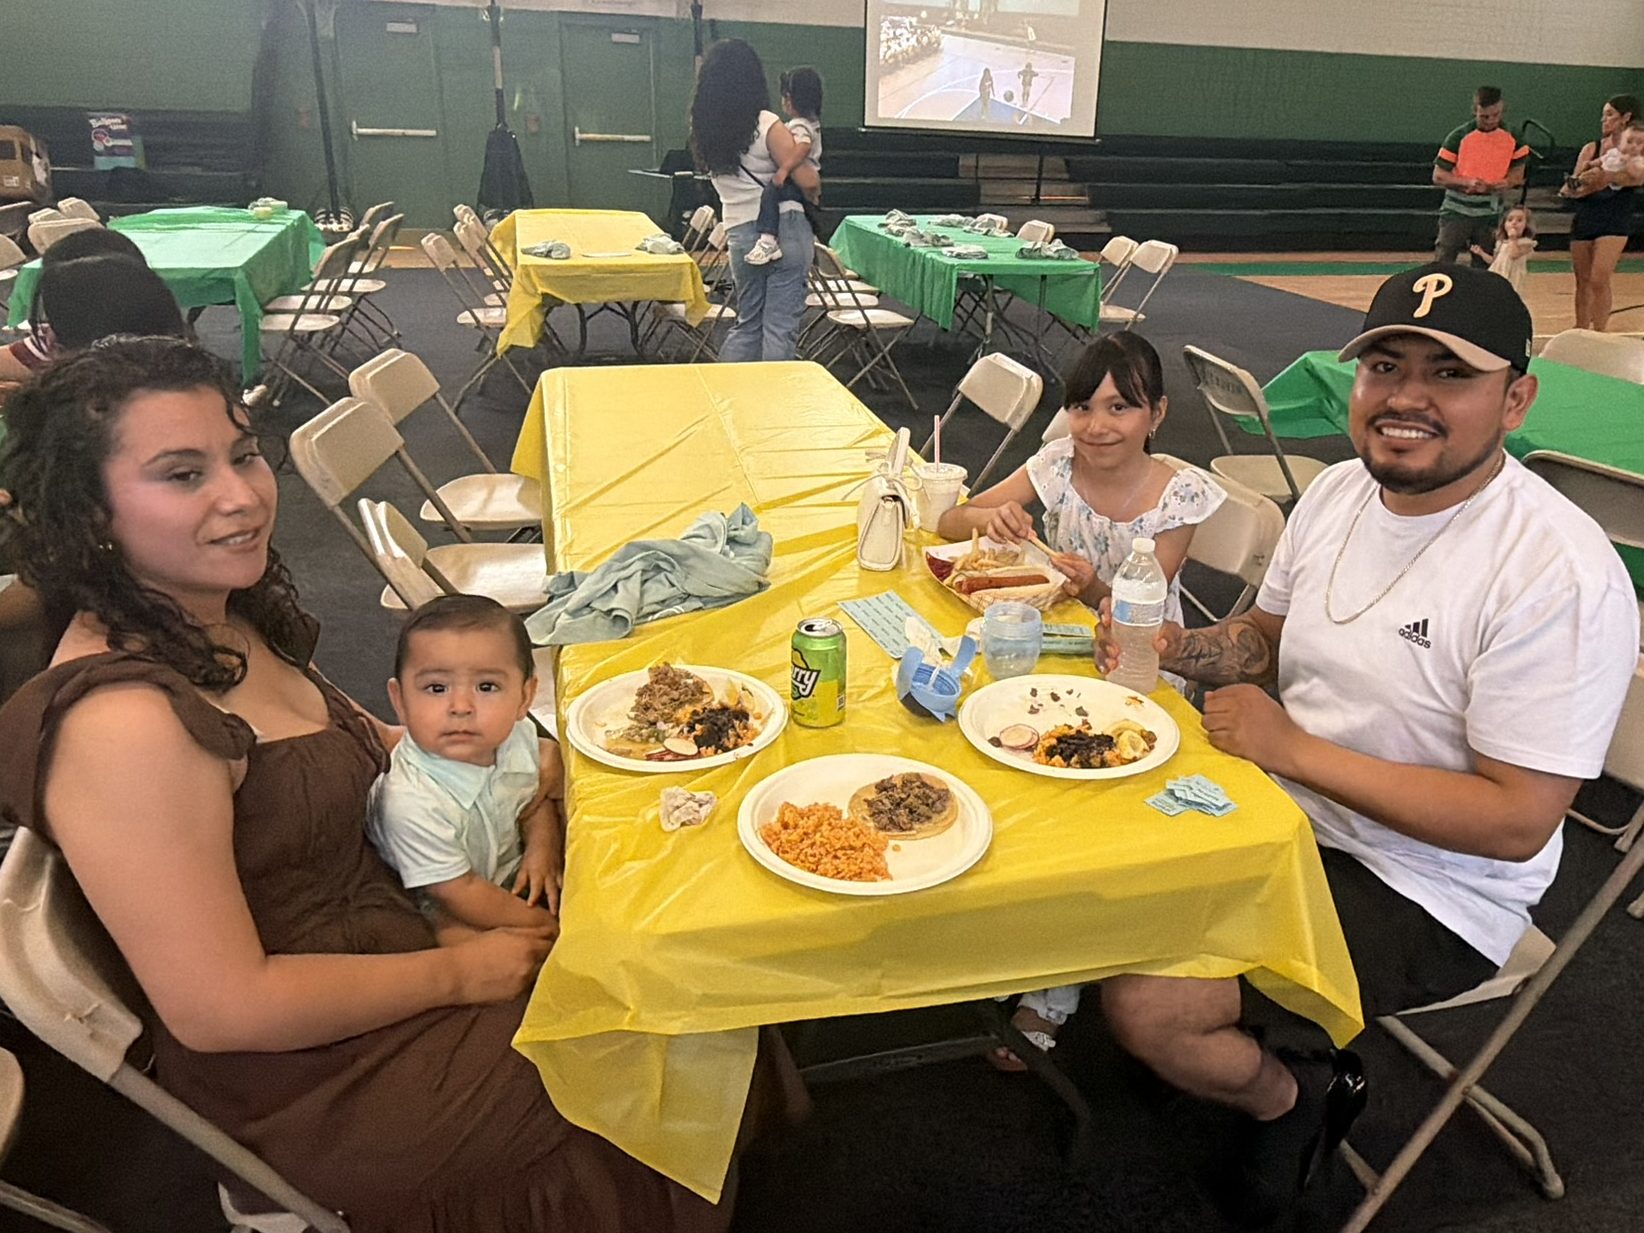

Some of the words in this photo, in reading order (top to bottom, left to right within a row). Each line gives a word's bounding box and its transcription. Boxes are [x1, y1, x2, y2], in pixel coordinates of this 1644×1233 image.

[1412, 273, 1453, 318] P
[1398, 627, 1431, 648] adidas
[791, 664, 819, 697] rry
